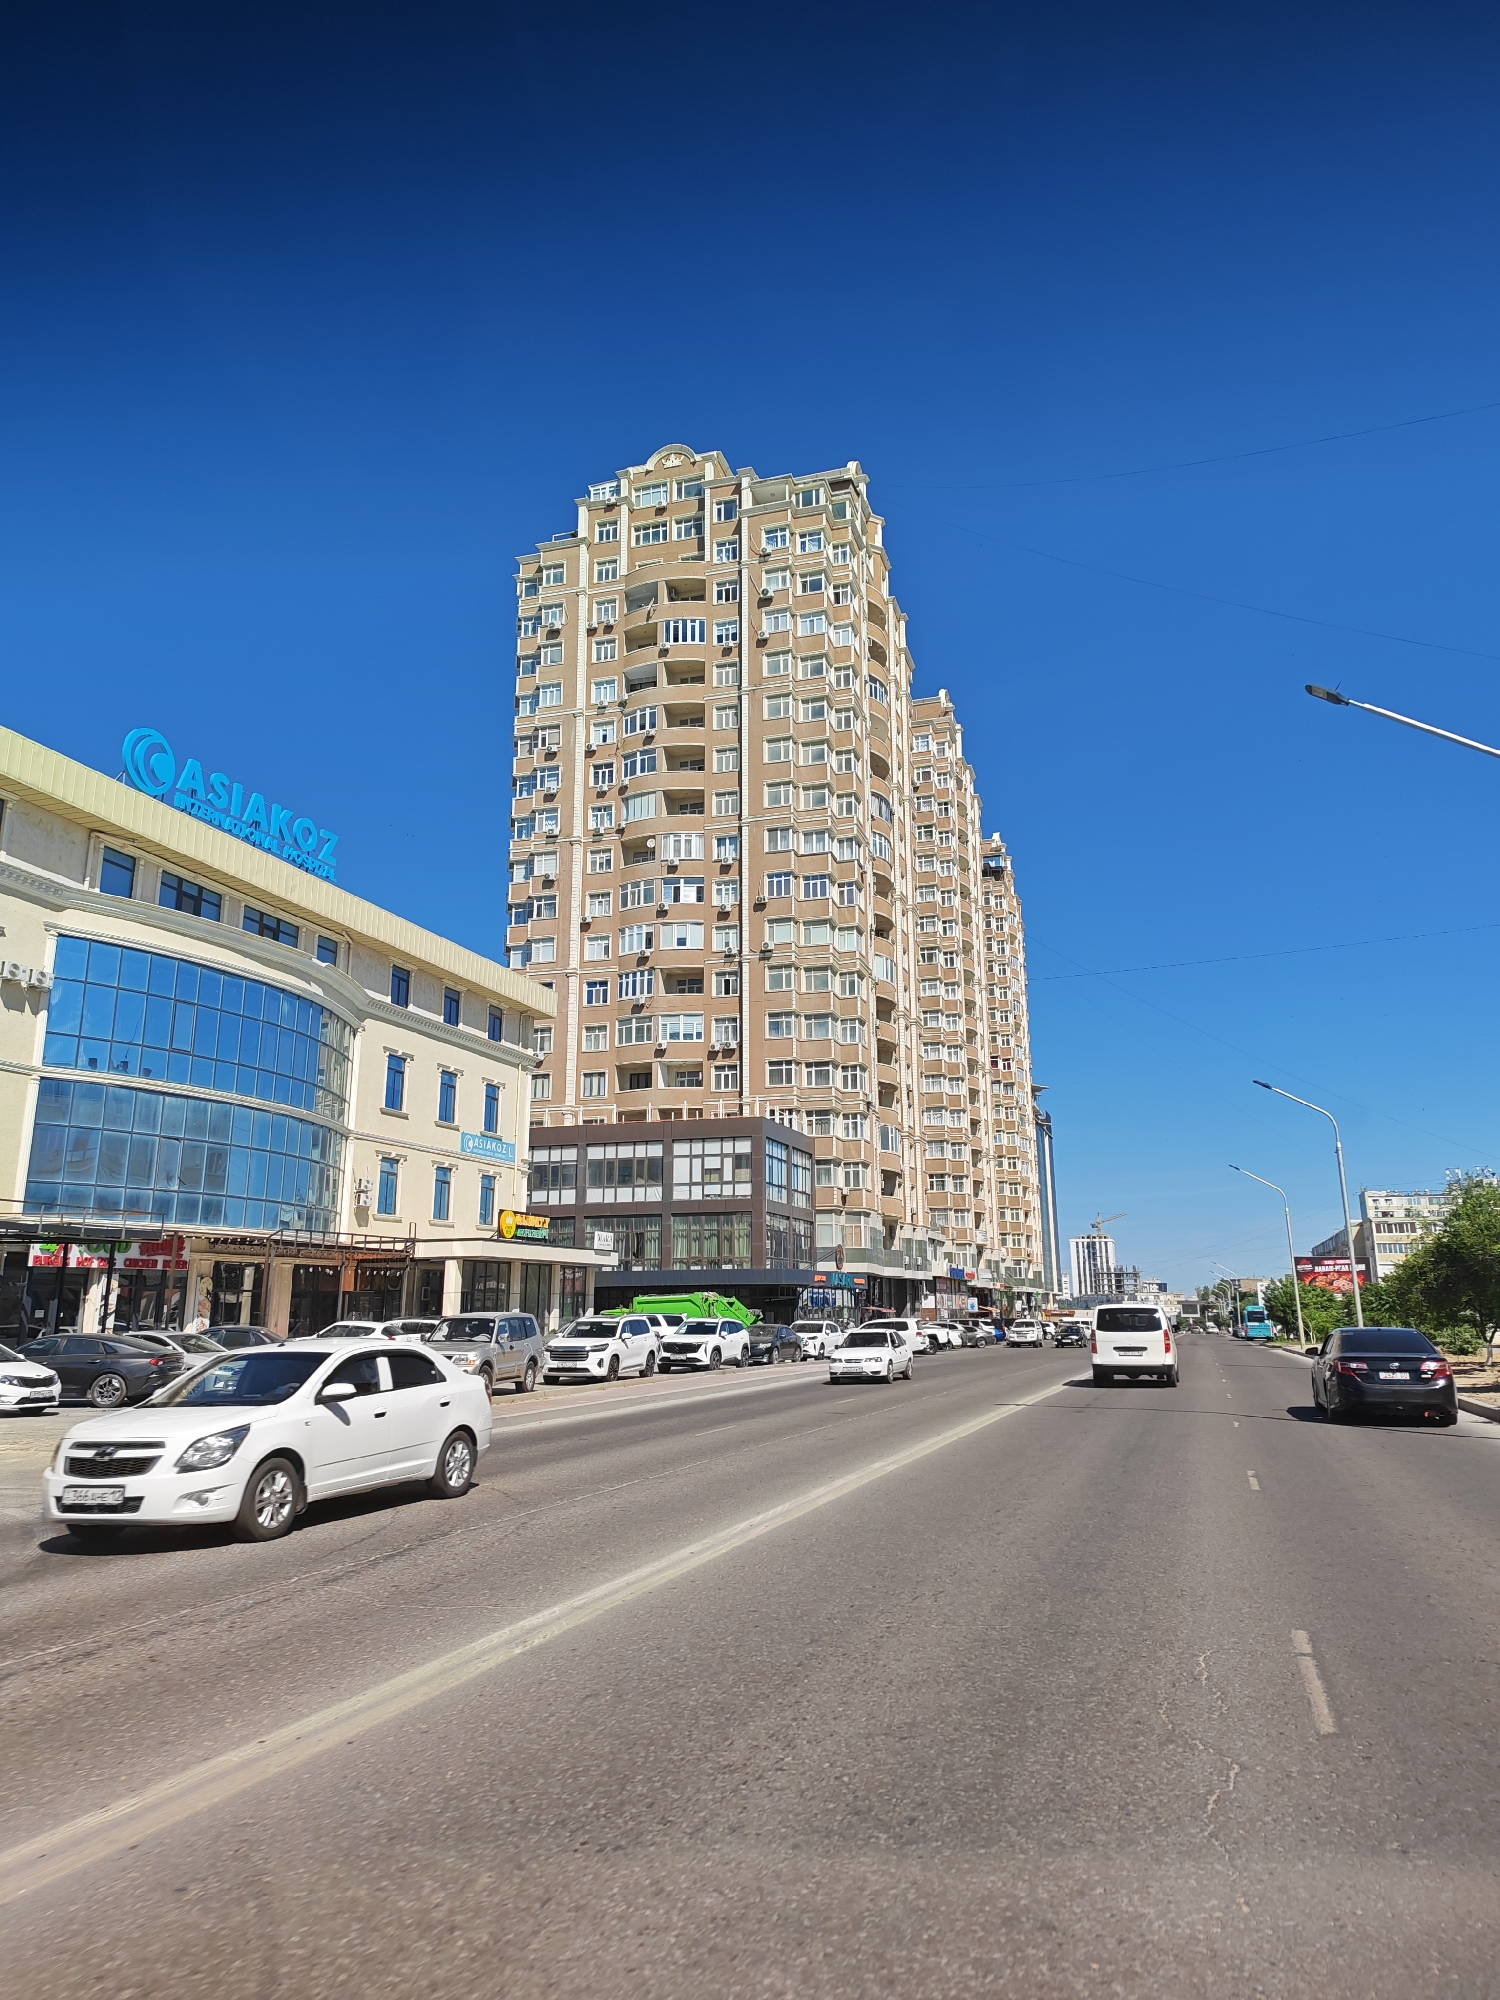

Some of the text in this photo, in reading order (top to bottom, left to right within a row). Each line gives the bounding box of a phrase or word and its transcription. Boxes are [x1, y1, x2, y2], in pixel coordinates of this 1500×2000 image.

[174, 792, 337, 882] INTERNATIONAL HOSPITAL
[176, 758, 339, 865] ASIAKOZ
[474, 1138, 507, 1153] ASIAKOZ
